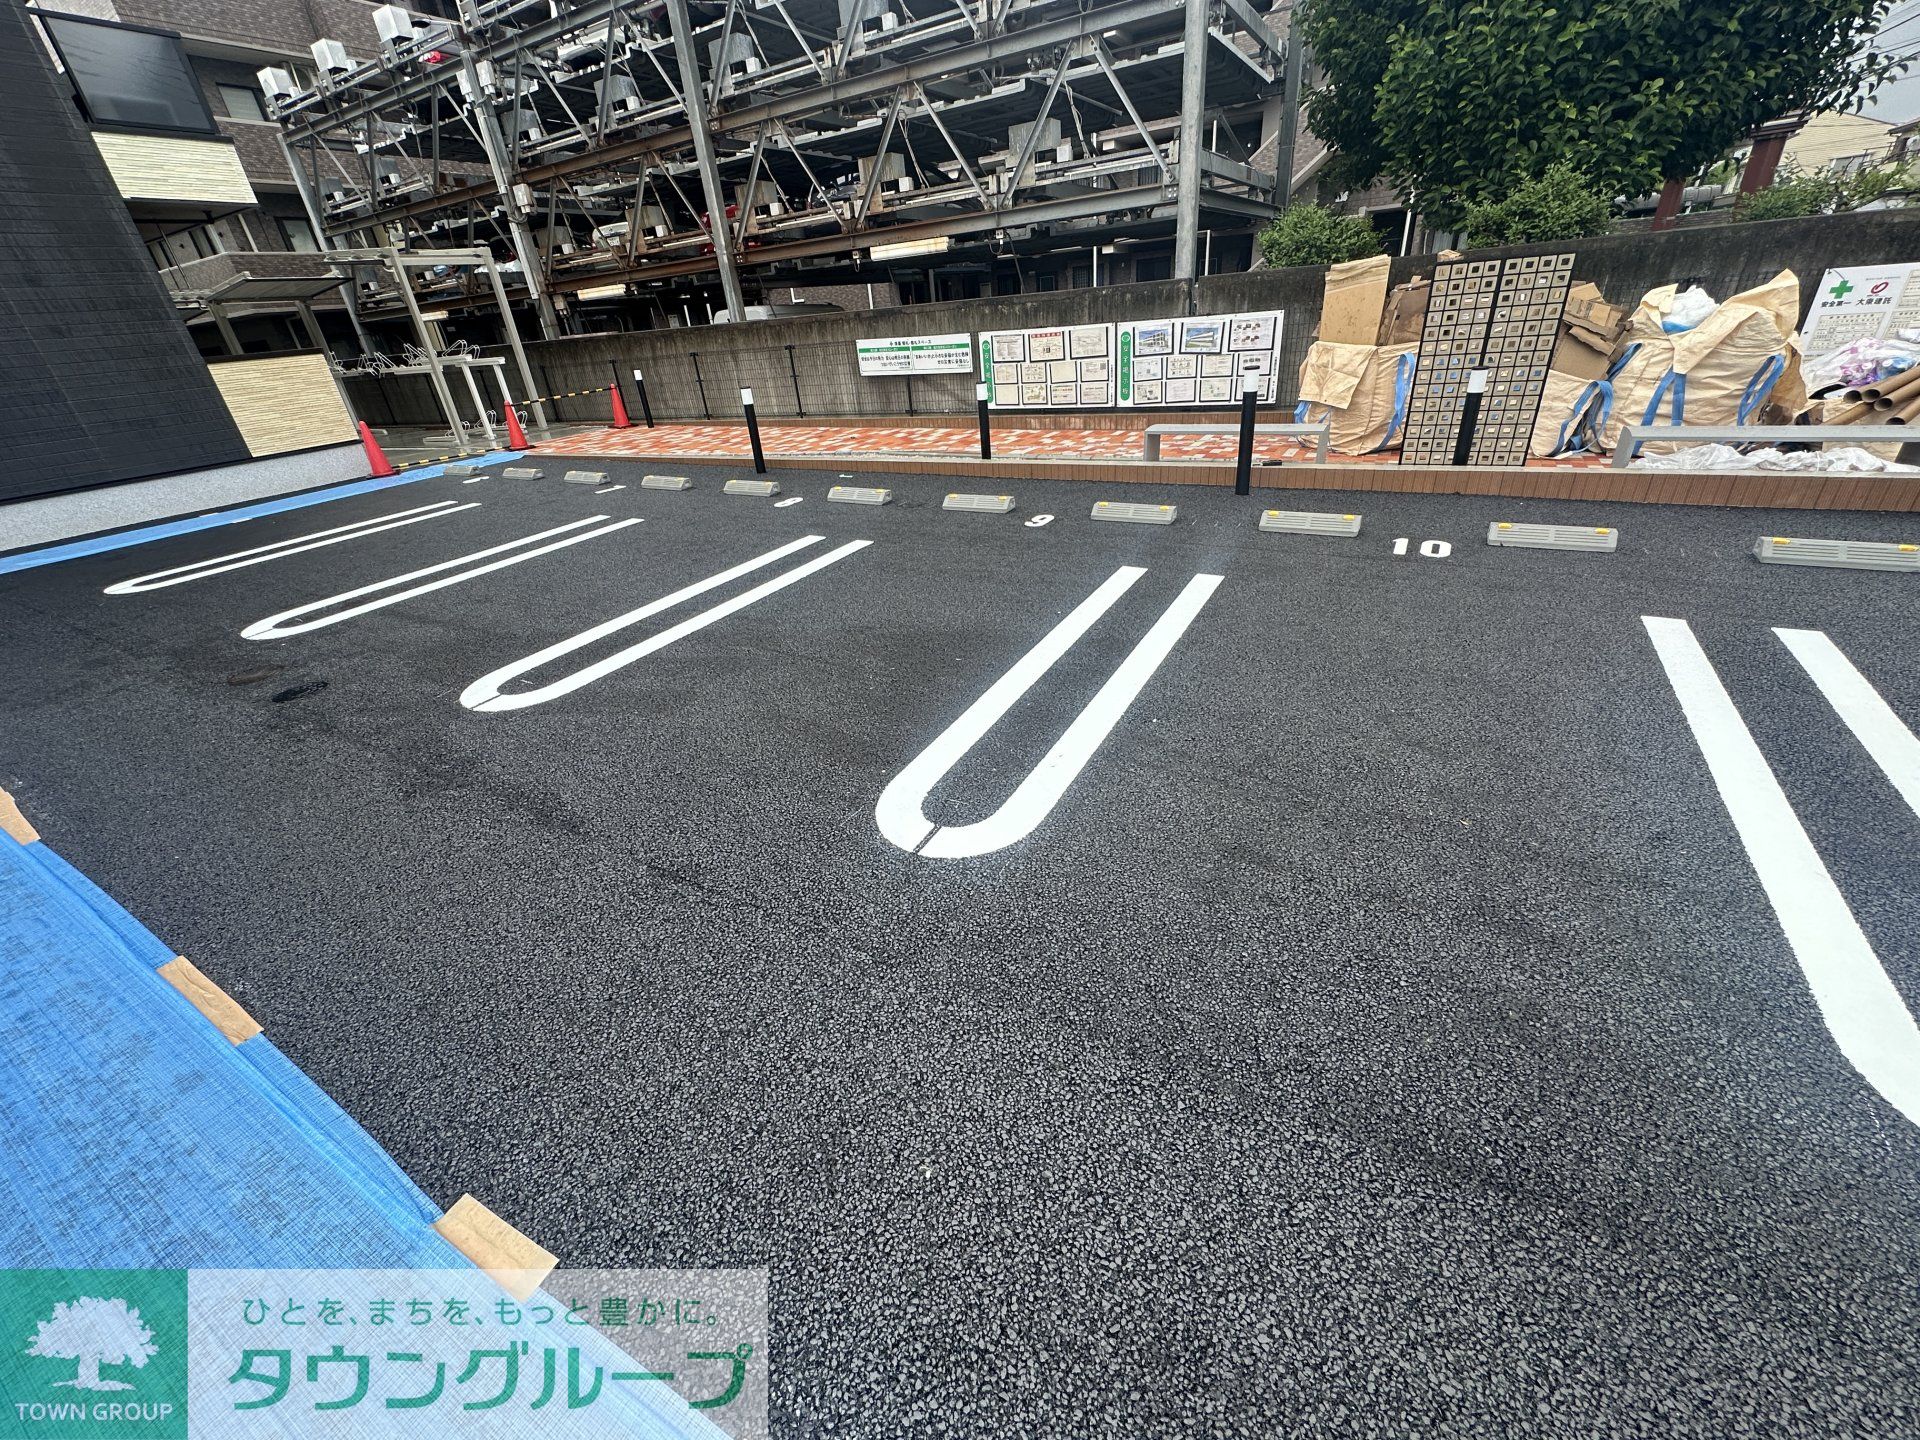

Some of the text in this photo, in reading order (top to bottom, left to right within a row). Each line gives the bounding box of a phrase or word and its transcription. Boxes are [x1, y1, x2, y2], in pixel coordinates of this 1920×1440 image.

[1821, 300, 1851, 308] 安全第一
[1024, 514, 1055, 528] 9
[1392, 537, 1452, 558] 10
